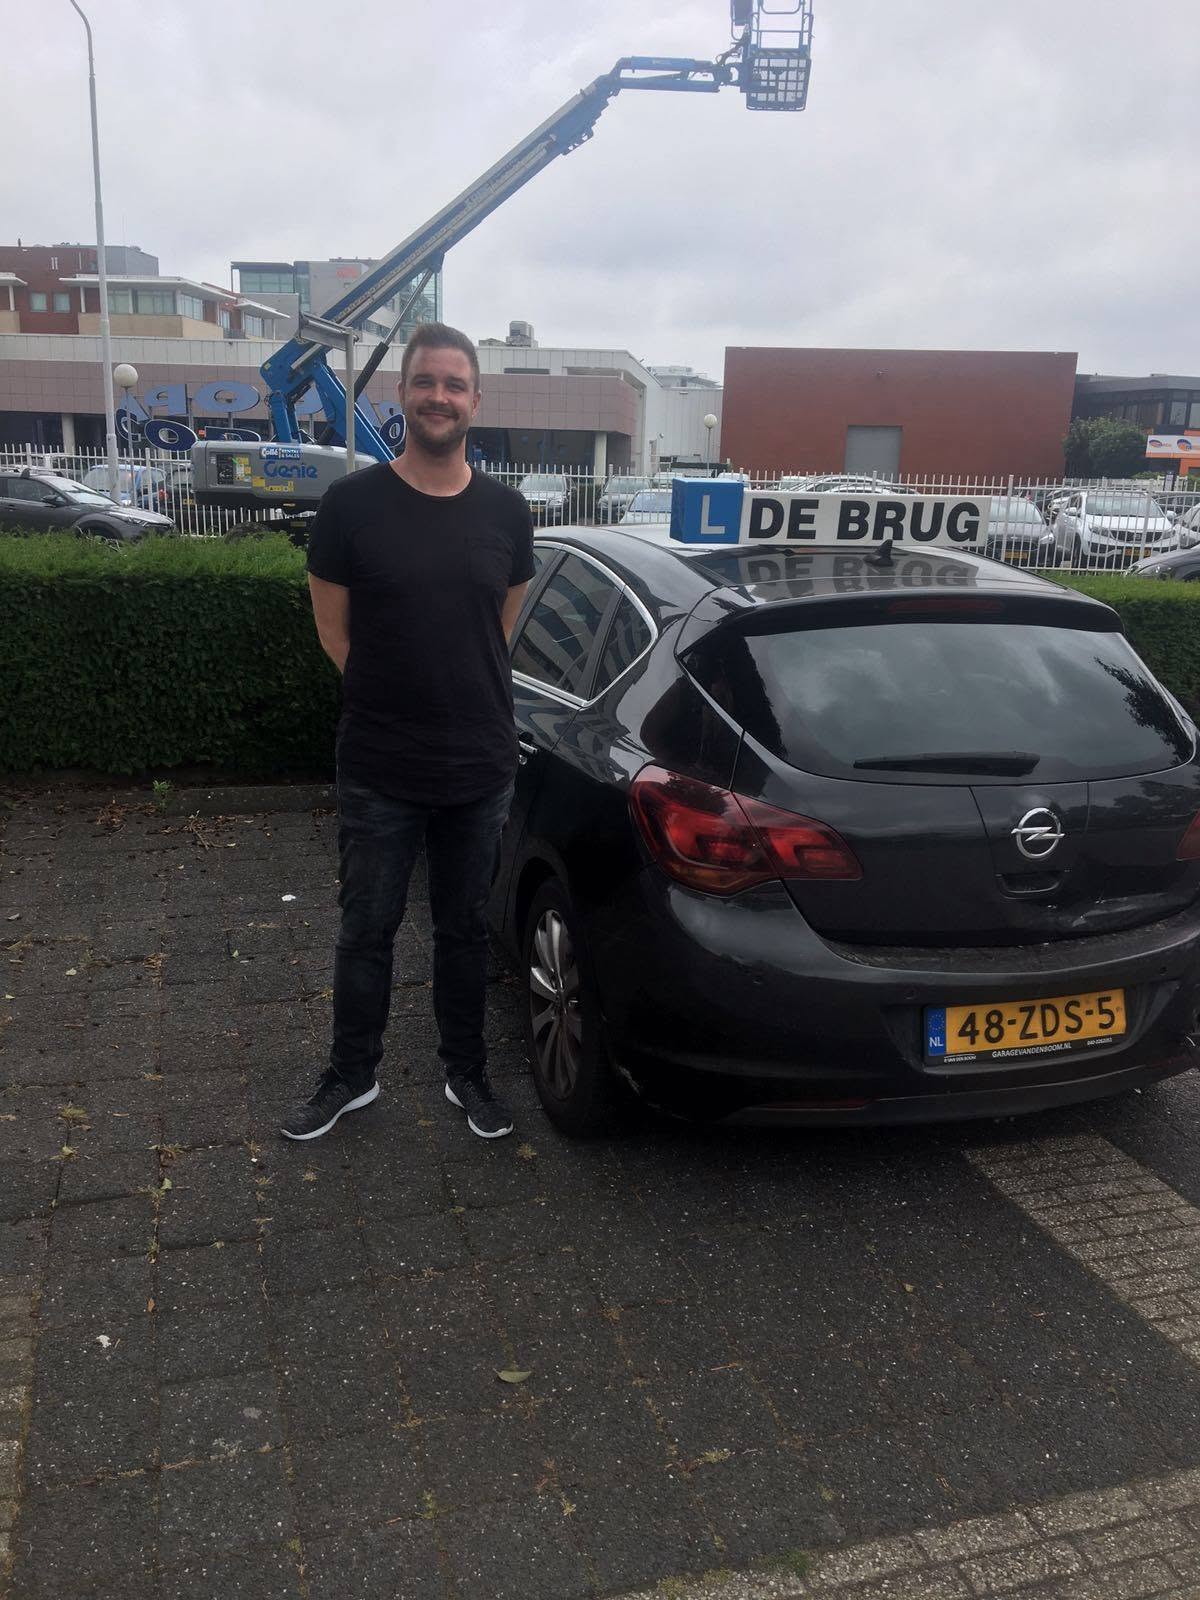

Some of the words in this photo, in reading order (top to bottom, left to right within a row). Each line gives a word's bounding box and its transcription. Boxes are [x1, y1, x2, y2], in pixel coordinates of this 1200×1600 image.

[264, 460, 318, 479] Genie
[700, 495, 726, 535] L
[748, 498, 820, 540] DE
[836, 500, 980, 543] BRUG
[957, 996, 1116, 1046] 48-ZDS-5
[929, 1036, 944, 1048] NL
[991, 1042, 1072, 1058] GARAGEVANDENBOOM.NL
